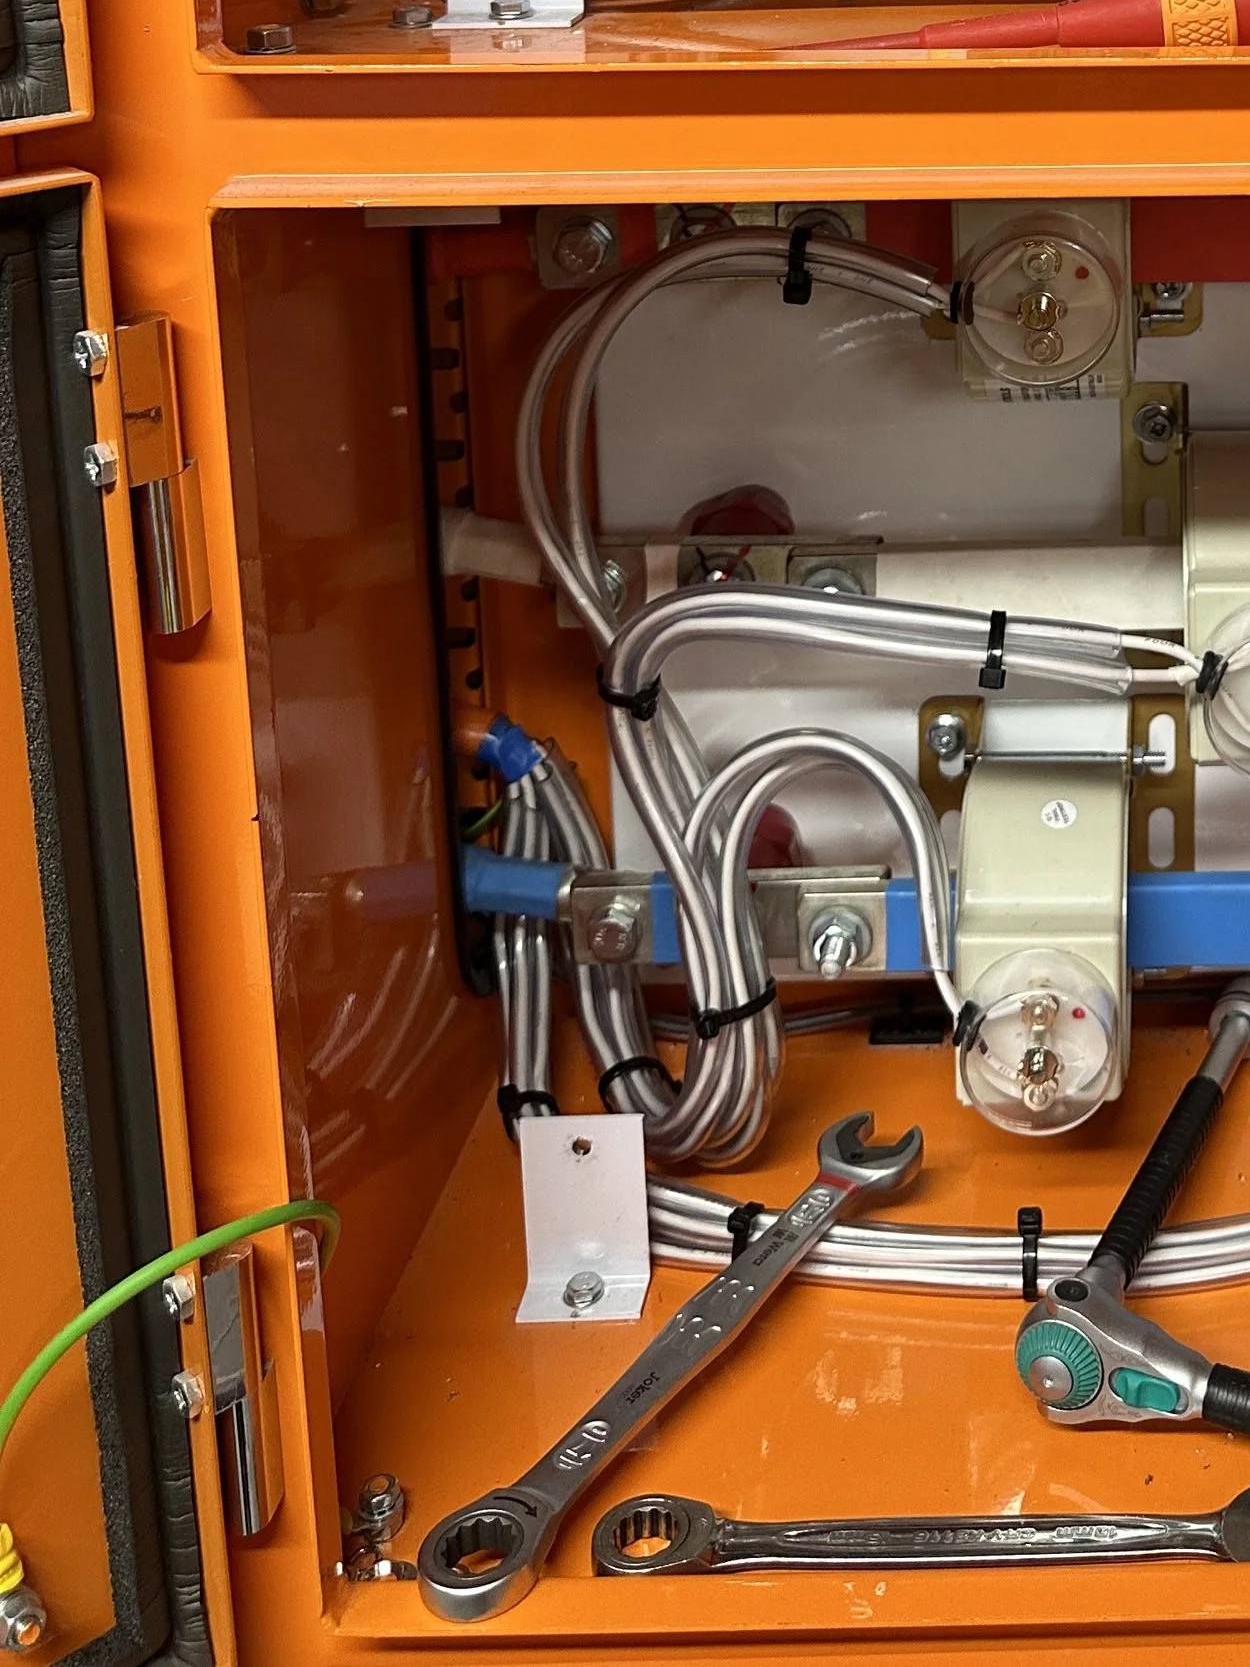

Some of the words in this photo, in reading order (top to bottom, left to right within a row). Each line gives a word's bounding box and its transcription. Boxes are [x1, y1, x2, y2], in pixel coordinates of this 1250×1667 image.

[854, 275, 873, 284] ONE
[1144, 636, 1176, 649] FOUR
[753, 1240, 786, 1267] Wera
[624, 1371, 661, 1405] Joker
